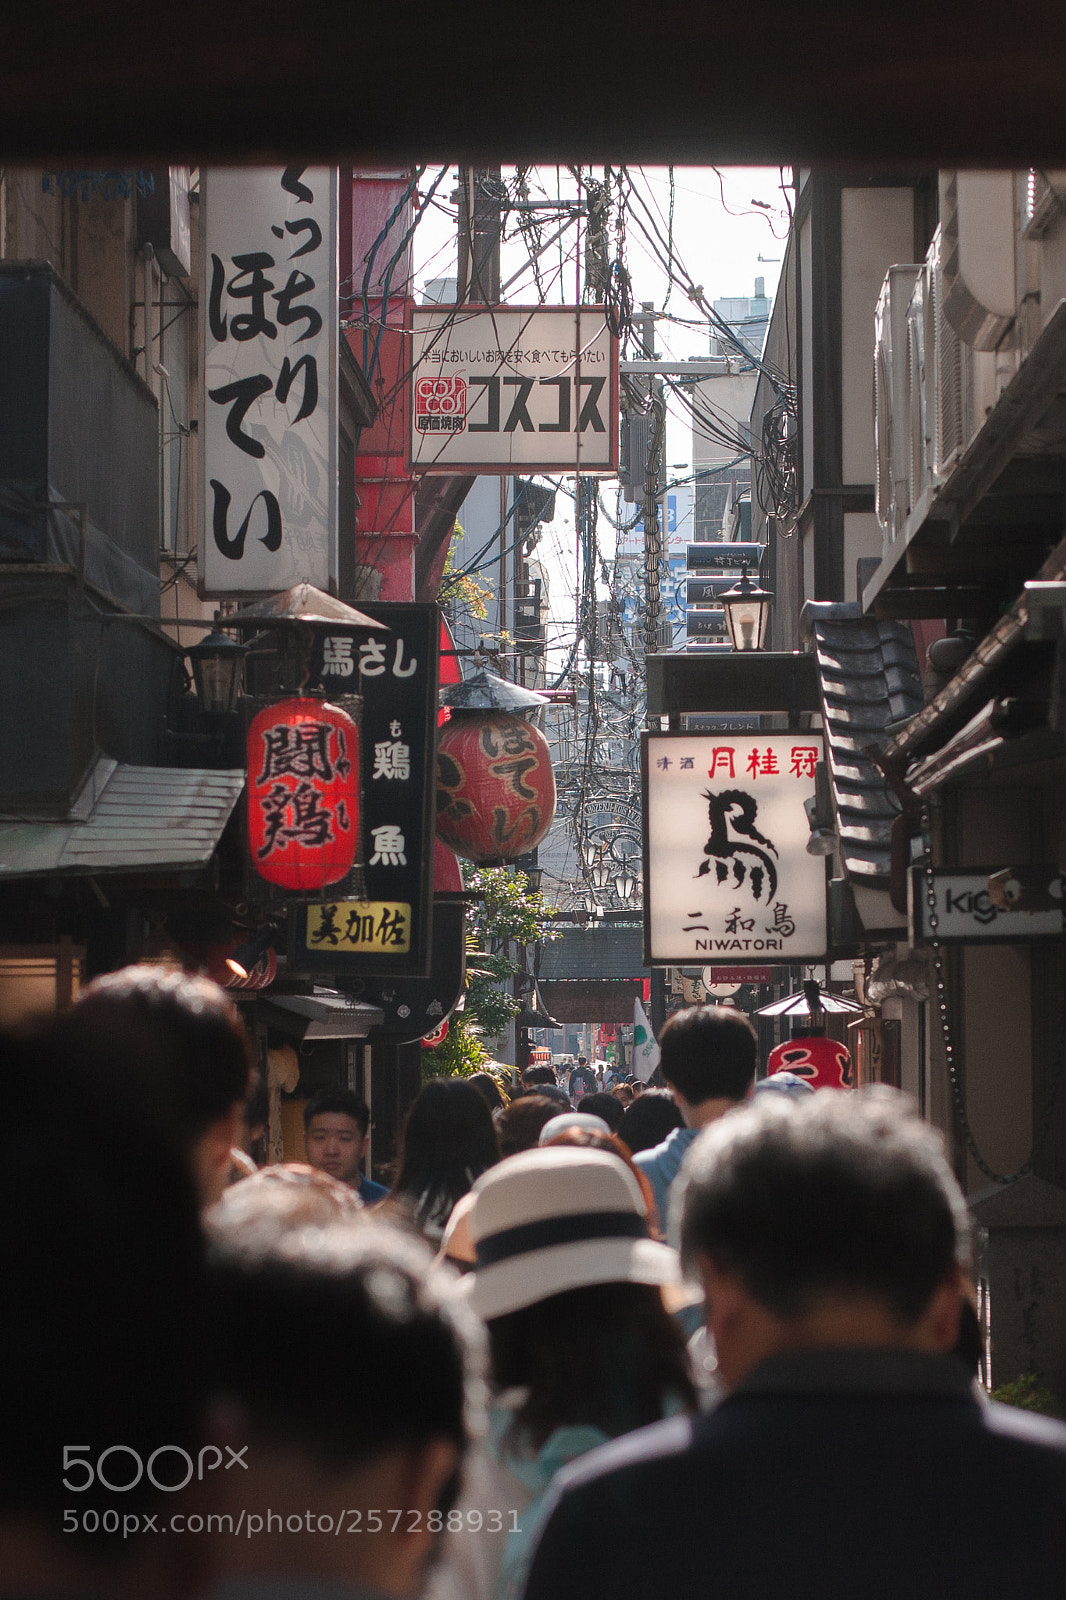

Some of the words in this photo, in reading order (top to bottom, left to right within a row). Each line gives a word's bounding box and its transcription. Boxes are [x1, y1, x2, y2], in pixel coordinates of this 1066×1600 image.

[208, 252, 283, 560] ほてい
[417, 415, 464, 431] 原価焼肉
[468, 376, 607, 433] コスコス
[321, 637, 418, 678] 馬さし
[708, 746, 818, 779] 月桂冠
[479, 723, 542, 844] ほてい
[369, 825, 408, 866] 魚
[311, 904, 406, 945] 美加佐
[682, 902, 796, 938] 二和鳥
[695, 939, 783, 951] NIWATORI
